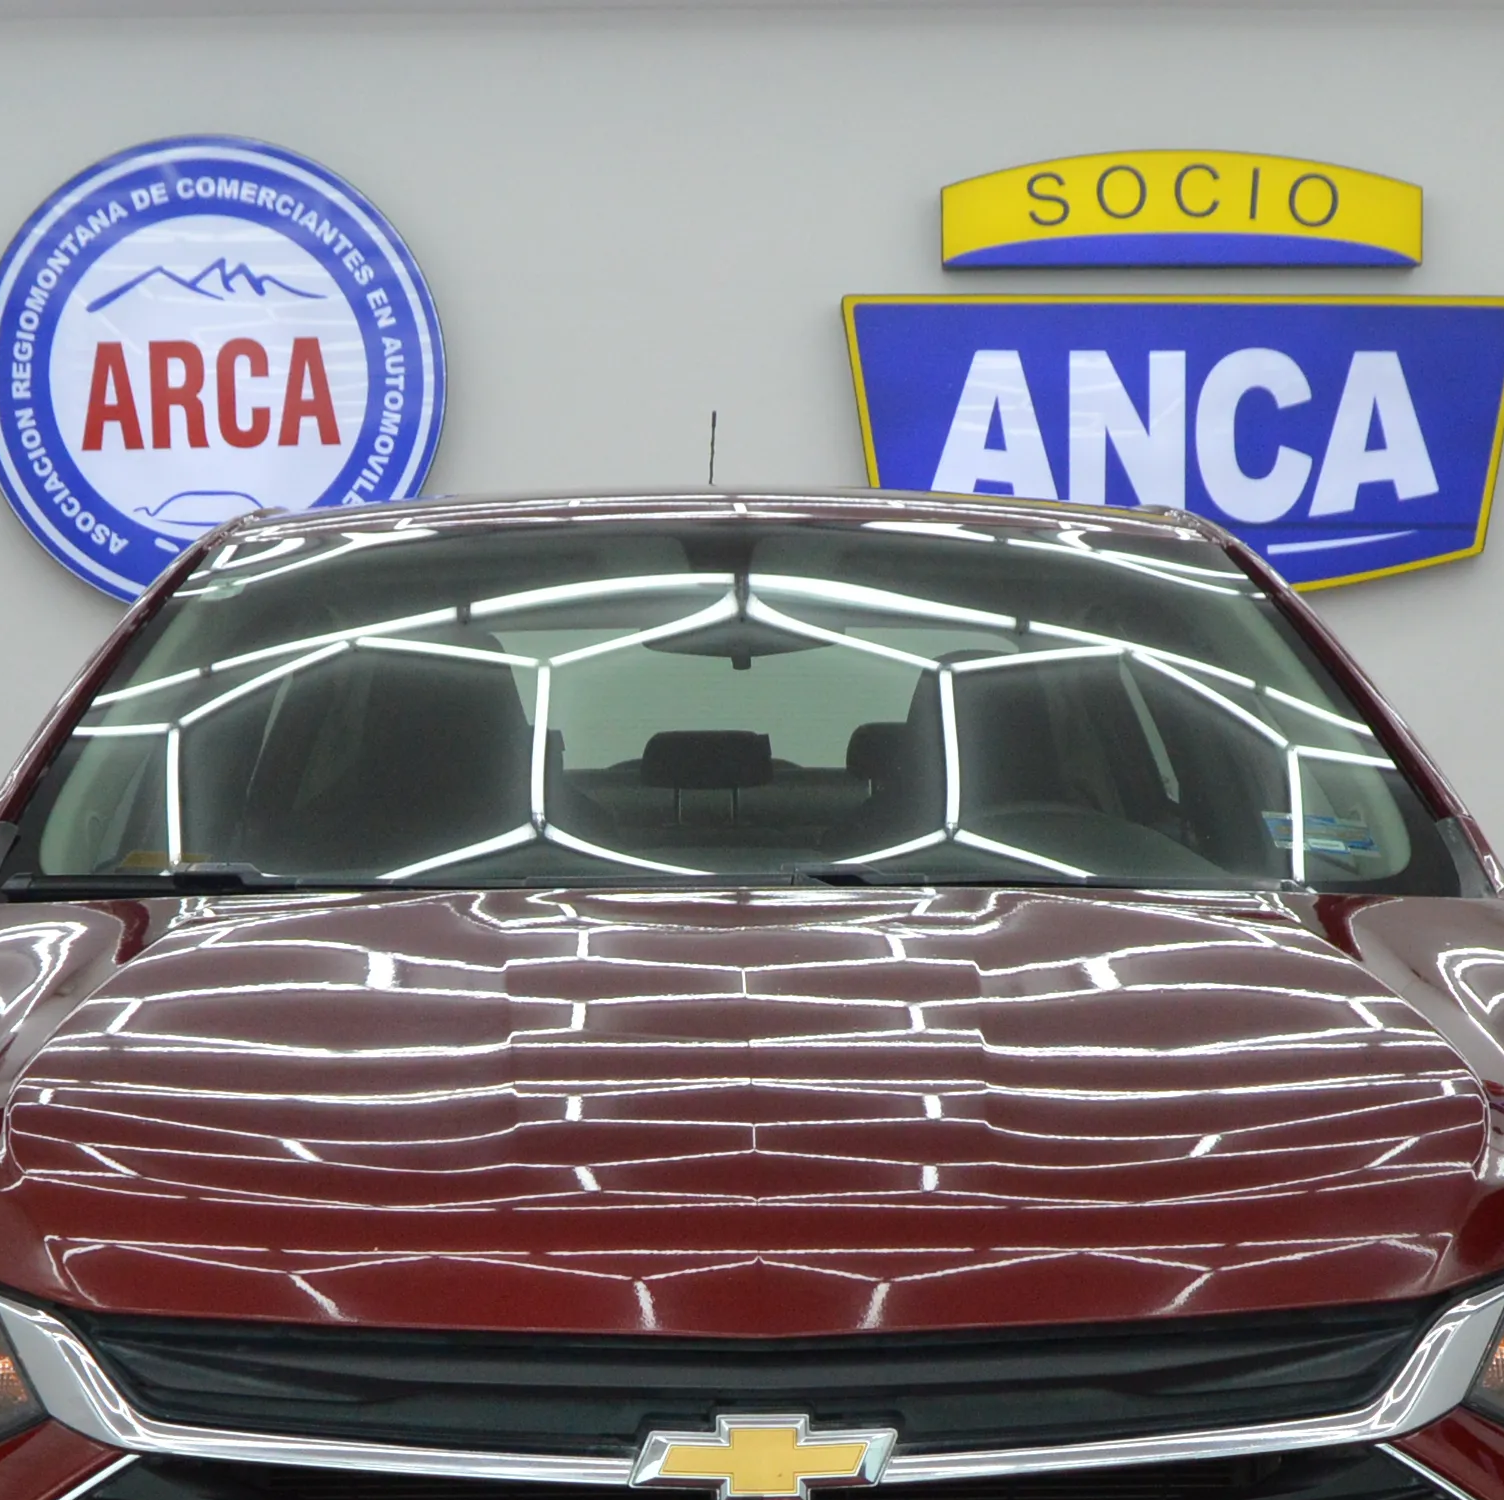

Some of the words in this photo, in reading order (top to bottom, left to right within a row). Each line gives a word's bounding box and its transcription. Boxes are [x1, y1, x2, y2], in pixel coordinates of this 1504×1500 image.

[130, 182, 170, 212] DE
[176, 176, 374, 287] COMERCIANTES
[1026, 164, 1339, 227] SOCIO
[11, 201, 129, 400] REGIOMONTANA
[366, 287, 397, 329] EN
[81, 336, 342, 452] ARCA
[930, 347, 1440, 524] ANCA
[14, 407, 129, 555] ASOCIACION
